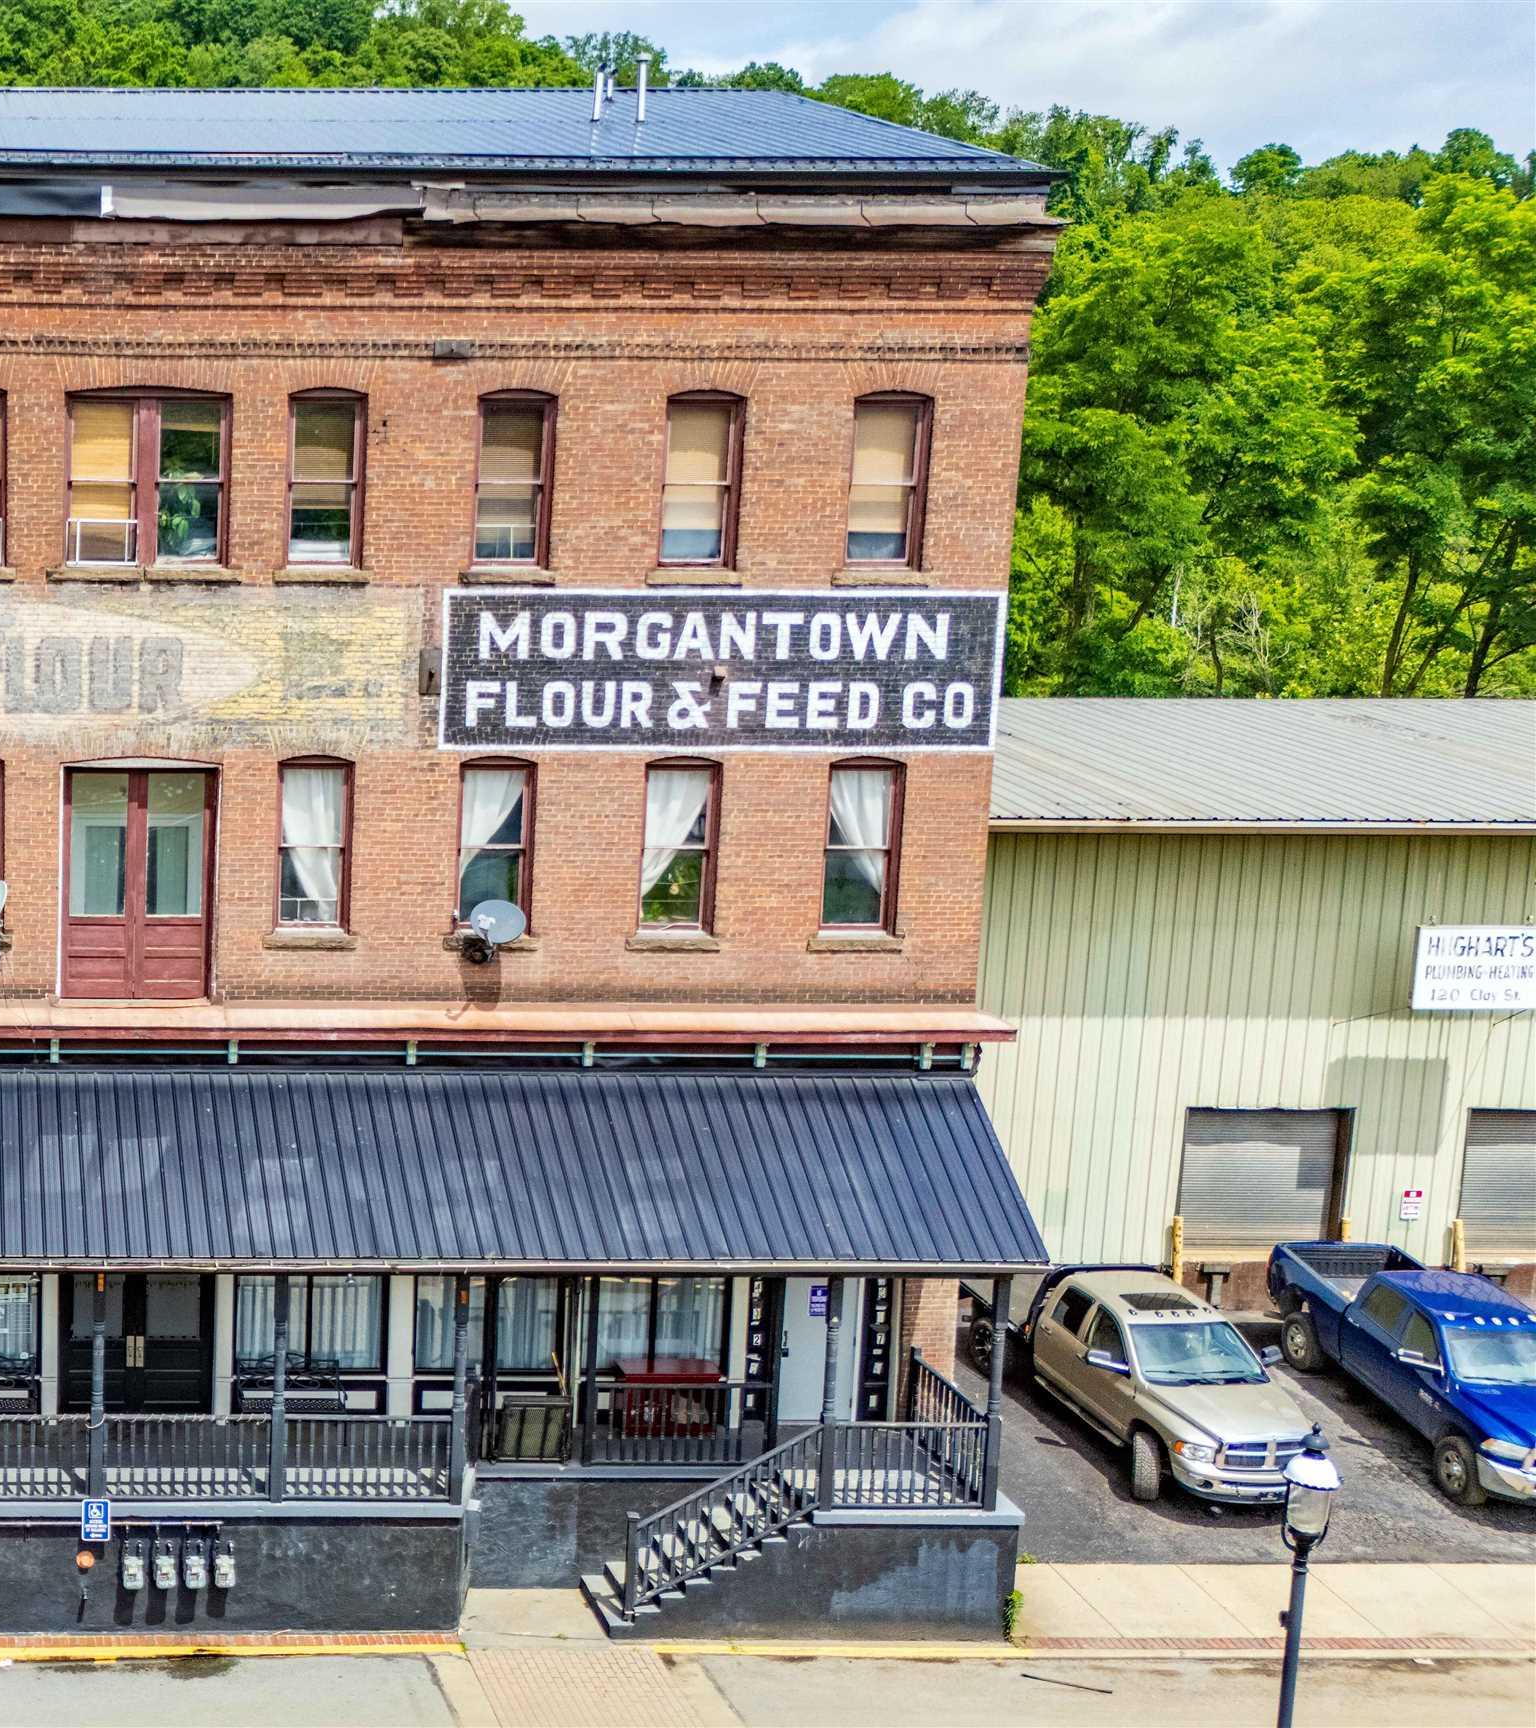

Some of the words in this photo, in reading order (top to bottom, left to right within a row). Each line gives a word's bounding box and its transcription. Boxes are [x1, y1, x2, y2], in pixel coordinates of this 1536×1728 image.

[477, 611, 951, 661] MORGANTOWN
[465, 680, 654, 729] FLOUR
[667, 680, 711, 730] &
[726, 681, 880, 730] FEED
[902, 681, 975, 729] CO
